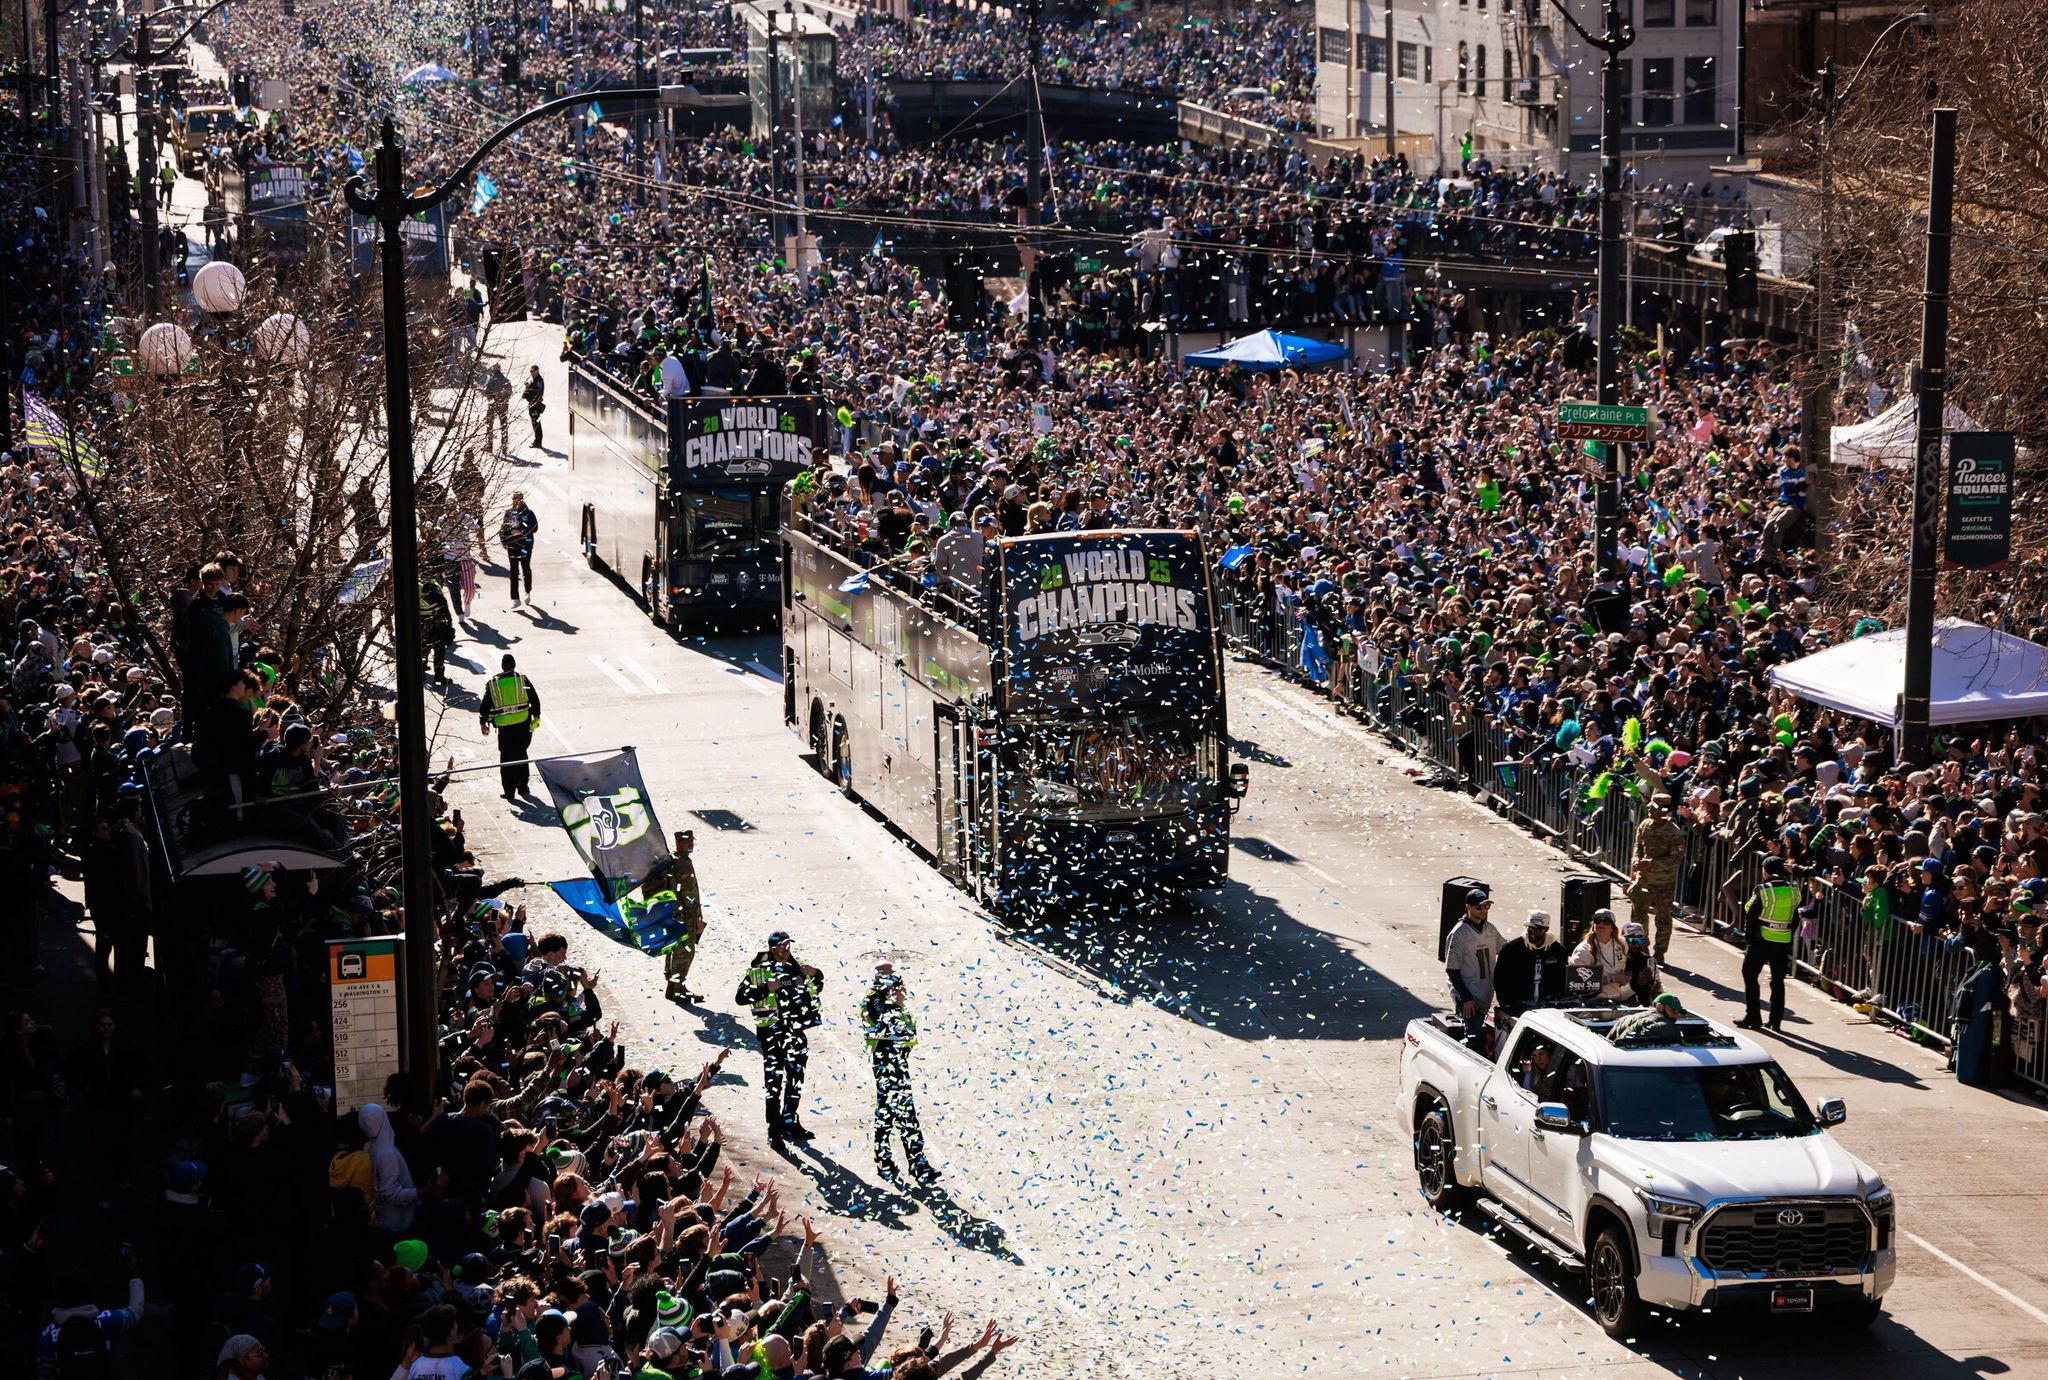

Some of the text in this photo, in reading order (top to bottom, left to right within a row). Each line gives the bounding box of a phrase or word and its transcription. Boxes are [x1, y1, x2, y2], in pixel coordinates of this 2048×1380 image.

[720, 406, 778, 431] WORLD
[780, 415, 796, 432] 25
[1561, 406, 1646, 422] Prefontaine Pl S
[686, 430, 812, 469] CHAMPIONS
[1955, 458, 2007, 483] Pioneer
[1953, 485, 2007, 495] SQUARE
[1065, 550, 1146, 584] WORLD
[1149, 559, 1171, 584] 25
[1018, 582, 1197, 641] CHAMPIONS
[1057, 668, 1073, 676] BUD
[1054, 674, 1078, 682] LIGHT
[1476, 947, 1491, 979] 11
[1569, 981, 1600, 990] Supa Sam
[343, 989, 381, 998] WASHINGTON
[333, 1001, 348, 1009] 256
[333, 1017, 348, 1025] 424
[335, 1033, 348, 1041] 510
